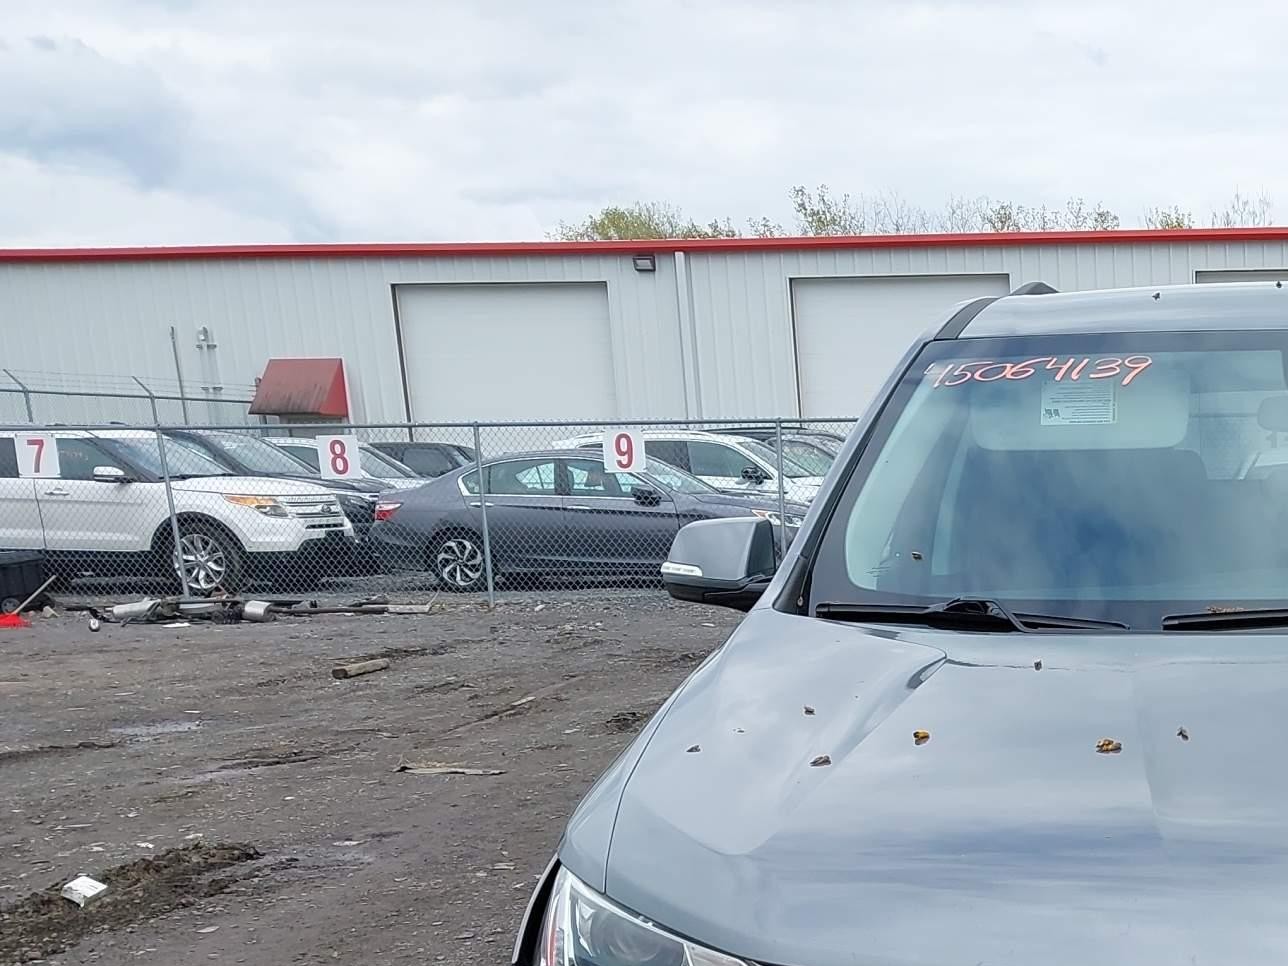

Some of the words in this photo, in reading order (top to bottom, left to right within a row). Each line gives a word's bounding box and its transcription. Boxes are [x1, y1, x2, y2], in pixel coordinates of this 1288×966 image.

[923, 355, 1153, 389] 45064139
[26, 439, 45, 474] 7
[329, 439, 349, 475] 8
[615, 433, 634, 470] 9
